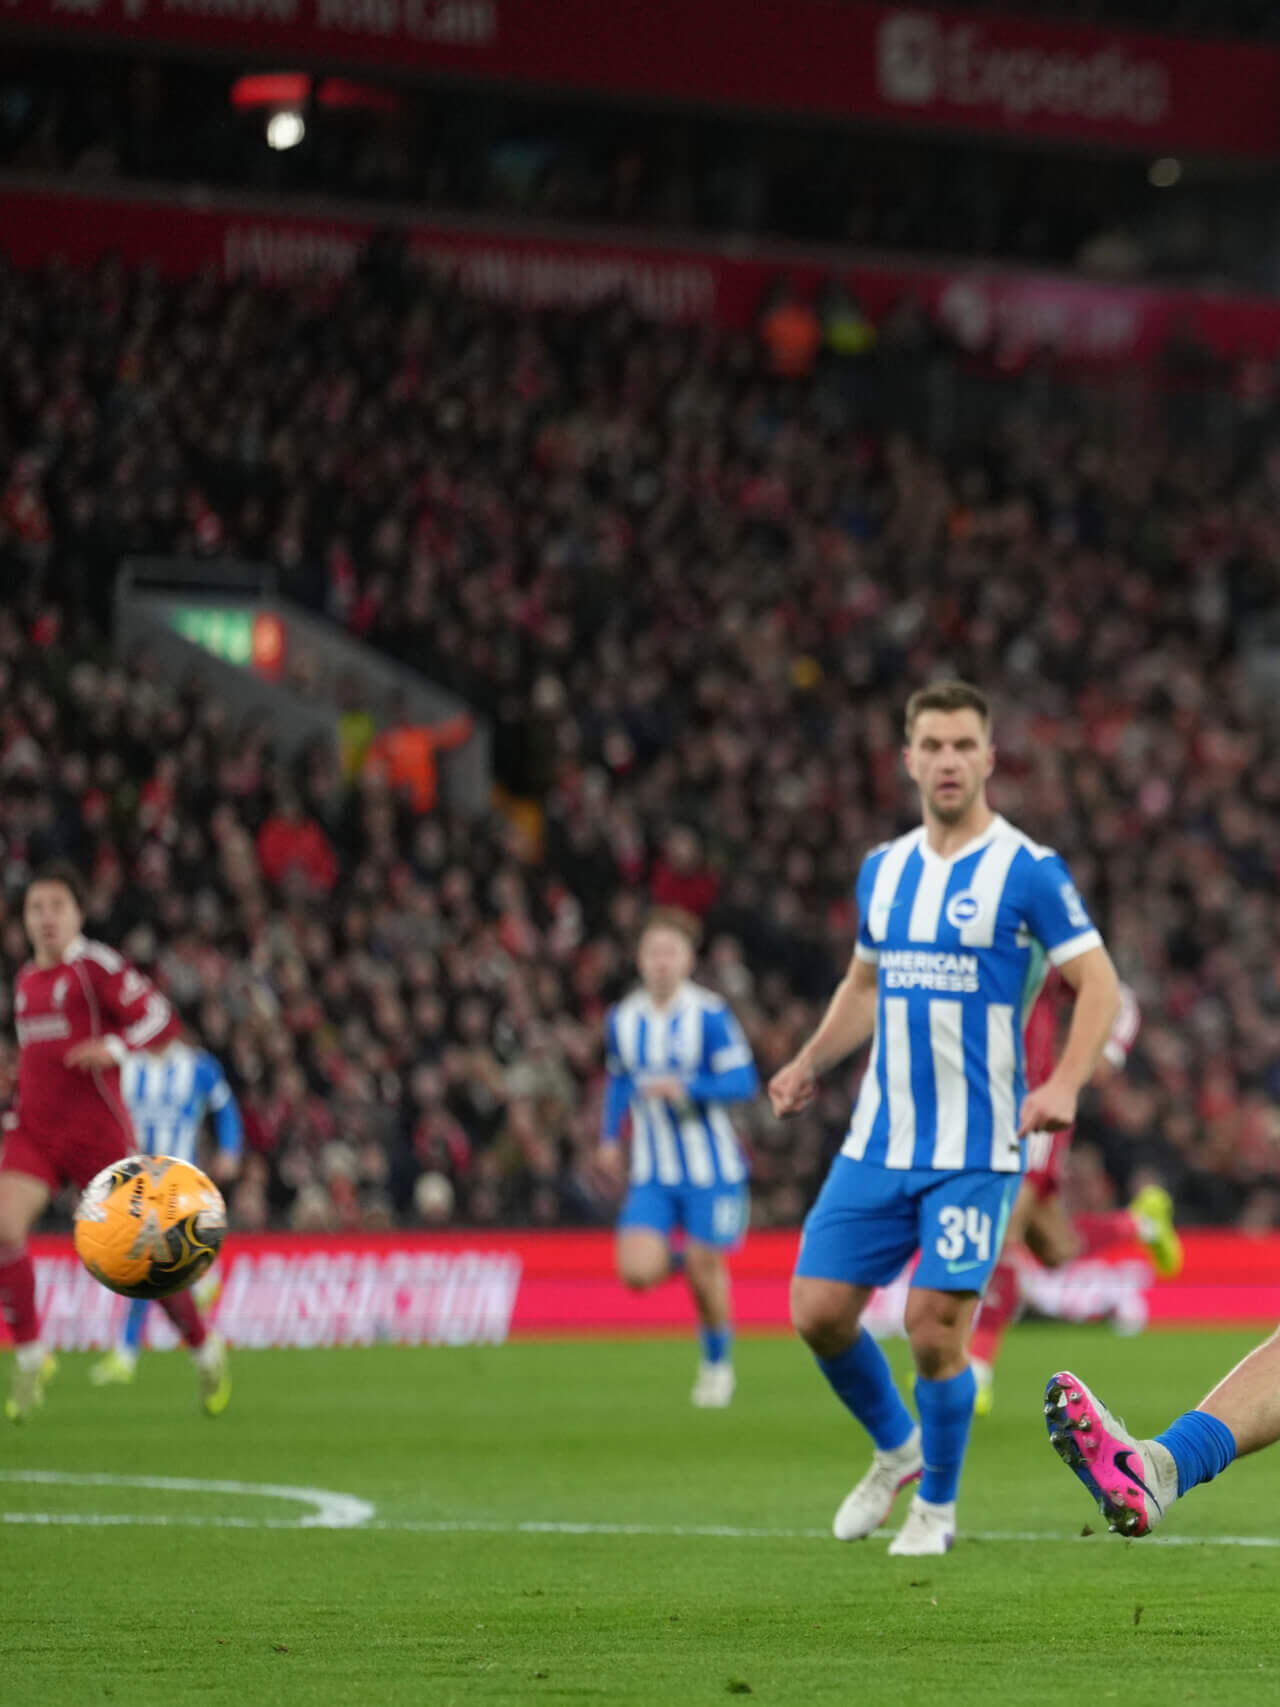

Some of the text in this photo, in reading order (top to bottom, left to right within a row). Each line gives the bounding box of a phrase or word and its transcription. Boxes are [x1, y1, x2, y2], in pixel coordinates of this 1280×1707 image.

[879, 950, 978, 975] AMERICAN
[885, 970, 980, 993] EXPRESS
[936, 1205, 992, 1262] 34
